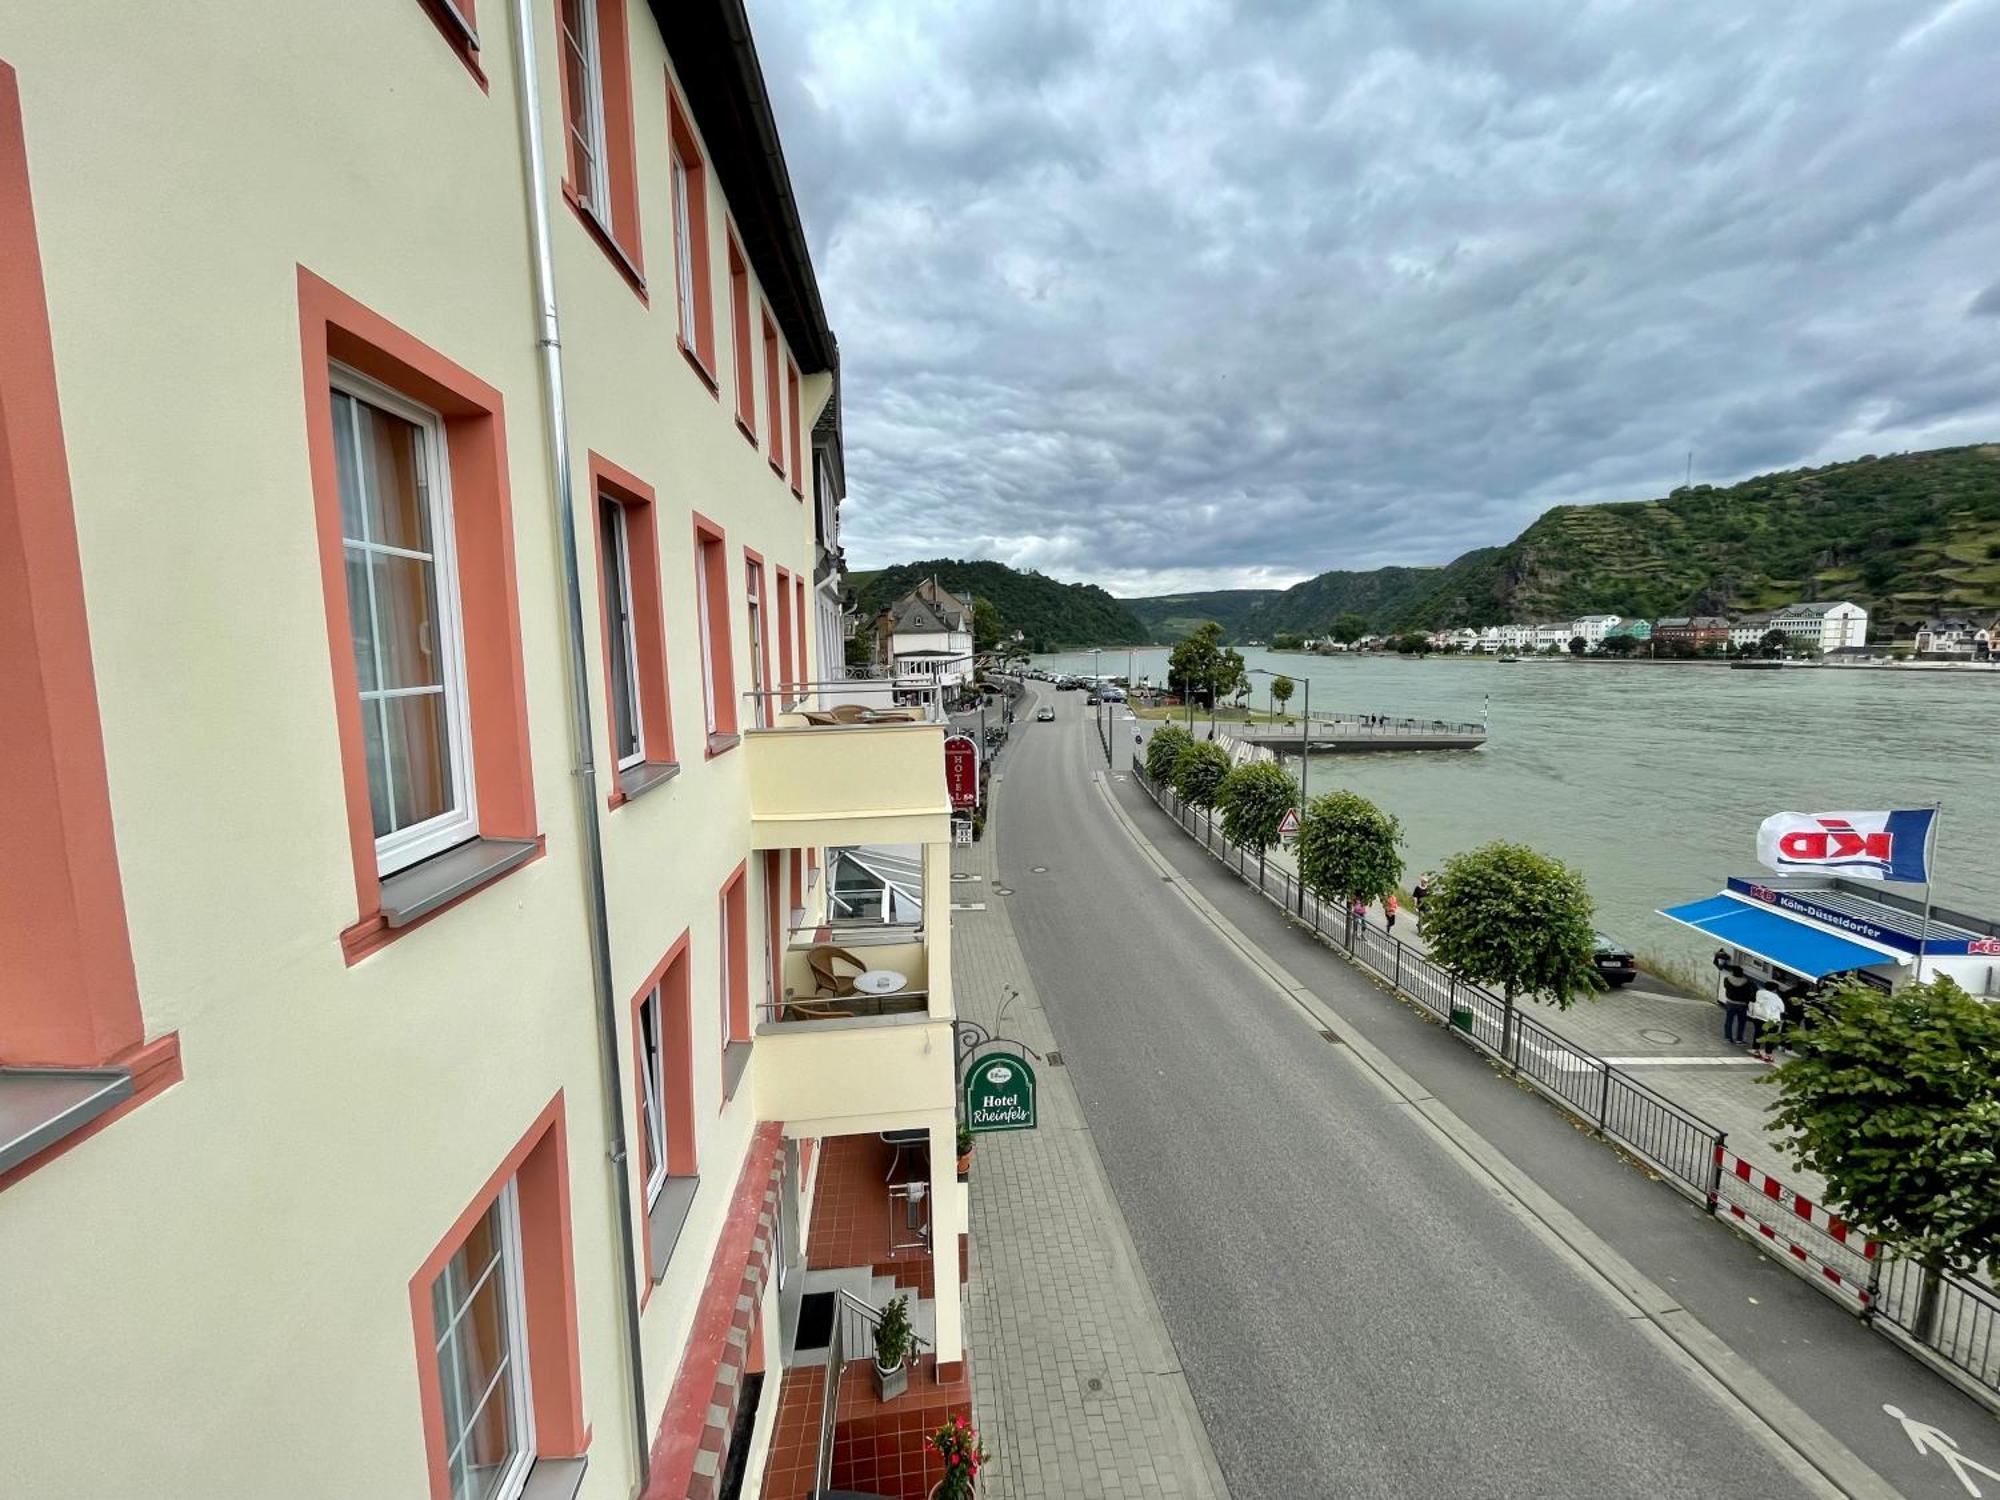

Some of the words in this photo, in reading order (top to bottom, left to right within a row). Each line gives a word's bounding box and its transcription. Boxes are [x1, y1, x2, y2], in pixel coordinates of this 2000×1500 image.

[954, 755, 963, 801] HOTEL
[1780, 896, 1881, 938] Köln-Düsseldorfer
[973, 1106, 1030, 1124] Rheinfels
[983, 1094, 1018, 1107] Hotel
